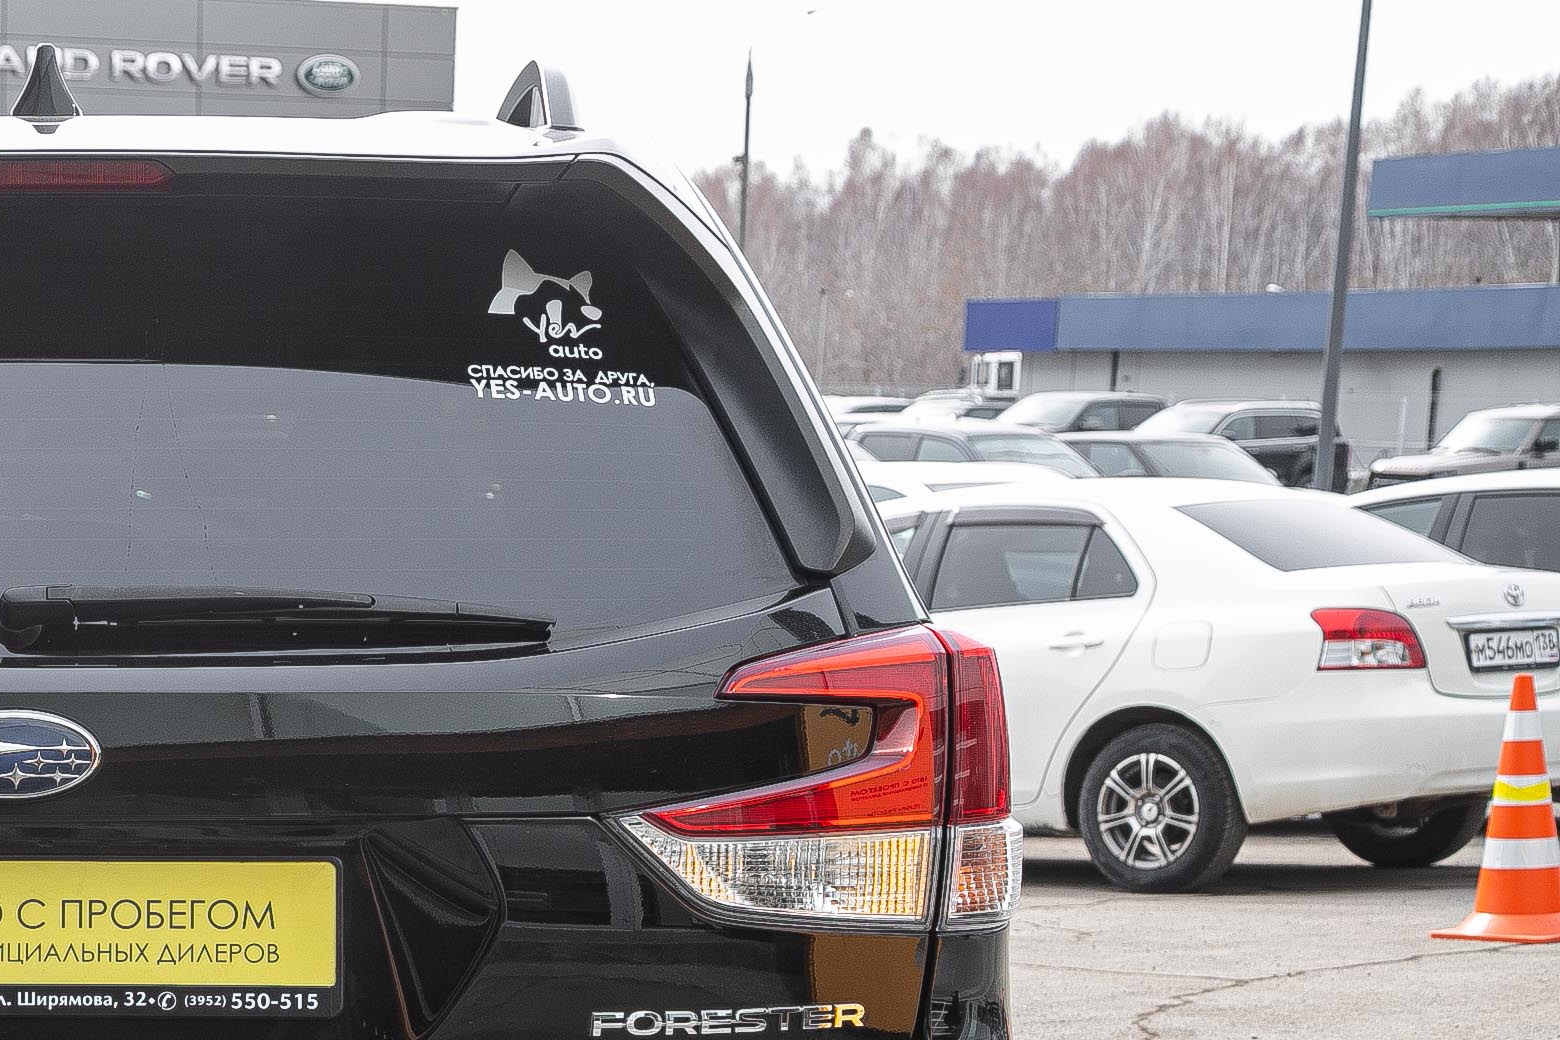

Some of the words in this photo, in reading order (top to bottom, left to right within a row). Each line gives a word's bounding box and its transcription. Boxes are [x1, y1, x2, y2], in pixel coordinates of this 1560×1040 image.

[111, 48, 283, 86] ROVER
[548, 343, 603, 360] auto
[467, 364, 559, 381] СПАСИБО
[562, 368, 587, 382] ЗА
[469, 378, 657, 408] YES-AUTO.RU
[16, 898, 47, 930] С
[60, 898, 276, 930] ПРОБЕГОМ
[156, 942, 281, 966] ДИЛЕРОВ
[17, 990, 119, 1011] Ширямова,
[123, 990, 148, 1008] 32
[184, 993, 227, 1009] (3952)
[230, 992, 319, 1010] 550-515
[591, 1003, 866, 1037] FORESTER
